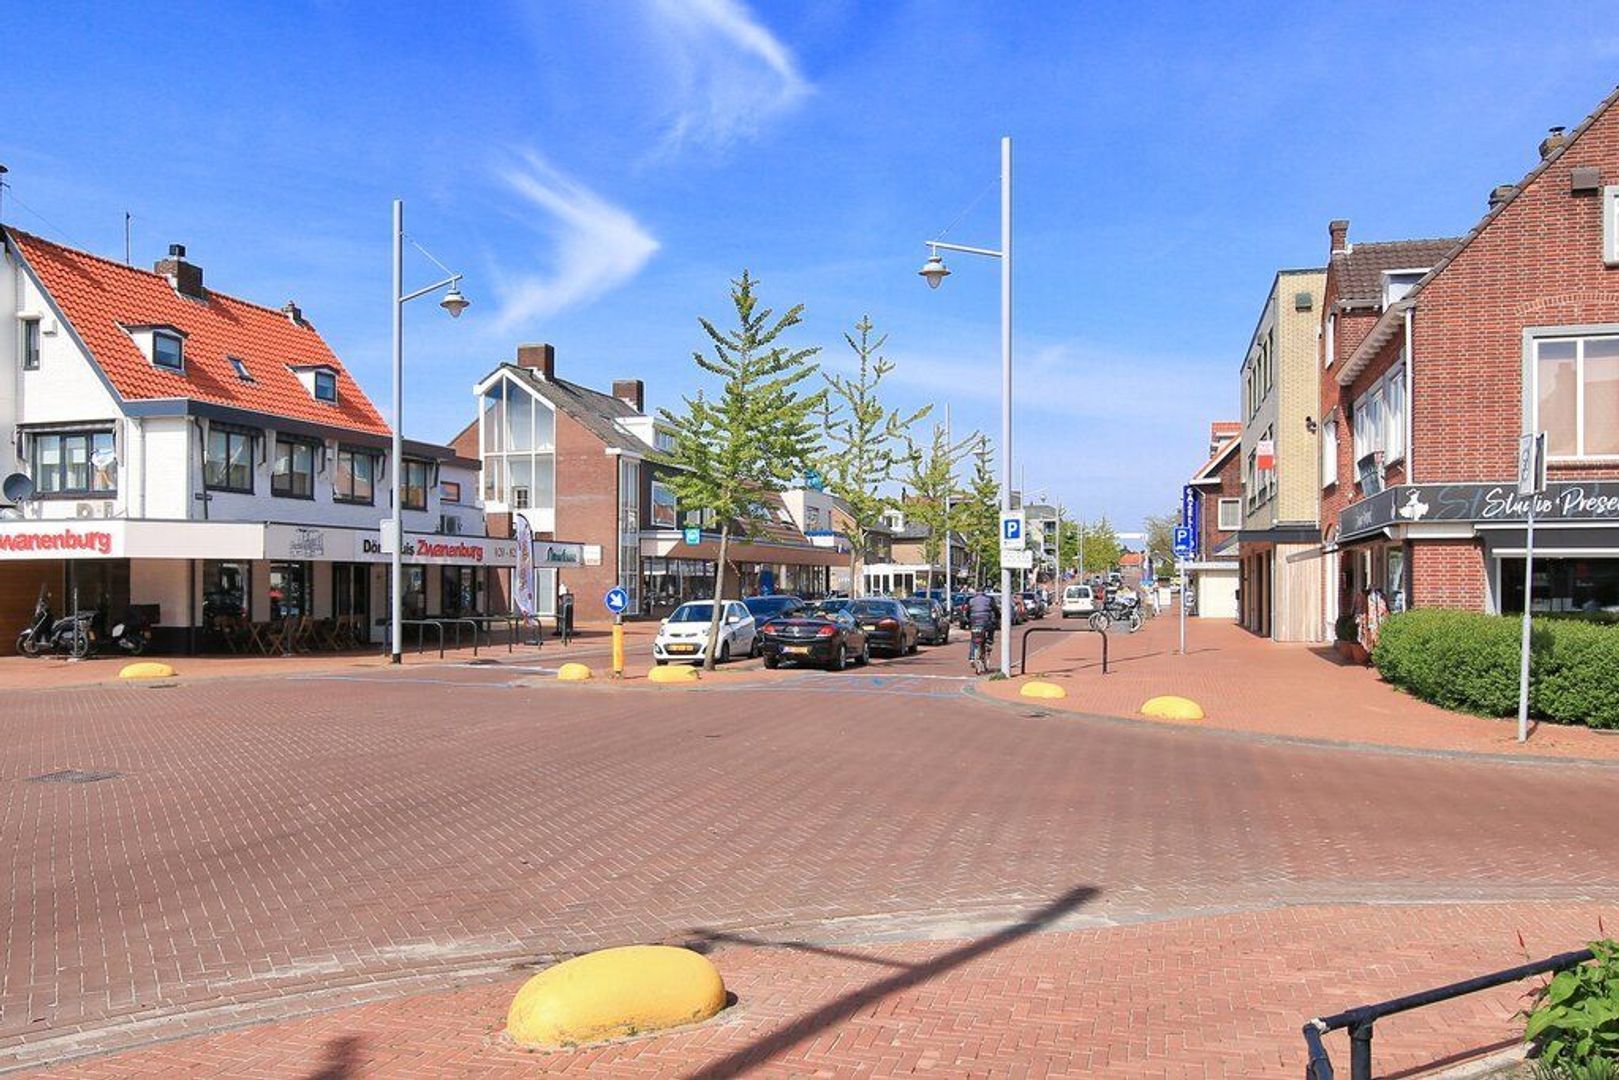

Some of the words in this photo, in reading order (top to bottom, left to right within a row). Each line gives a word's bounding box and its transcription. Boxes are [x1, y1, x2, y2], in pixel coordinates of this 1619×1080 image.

[1557, 487, 1619, 515] Prese
[1007, 521, 1018, 538] P
[1177, 529, 1187, 543] P
[416, 538, 483, 562] Zwanenburg
